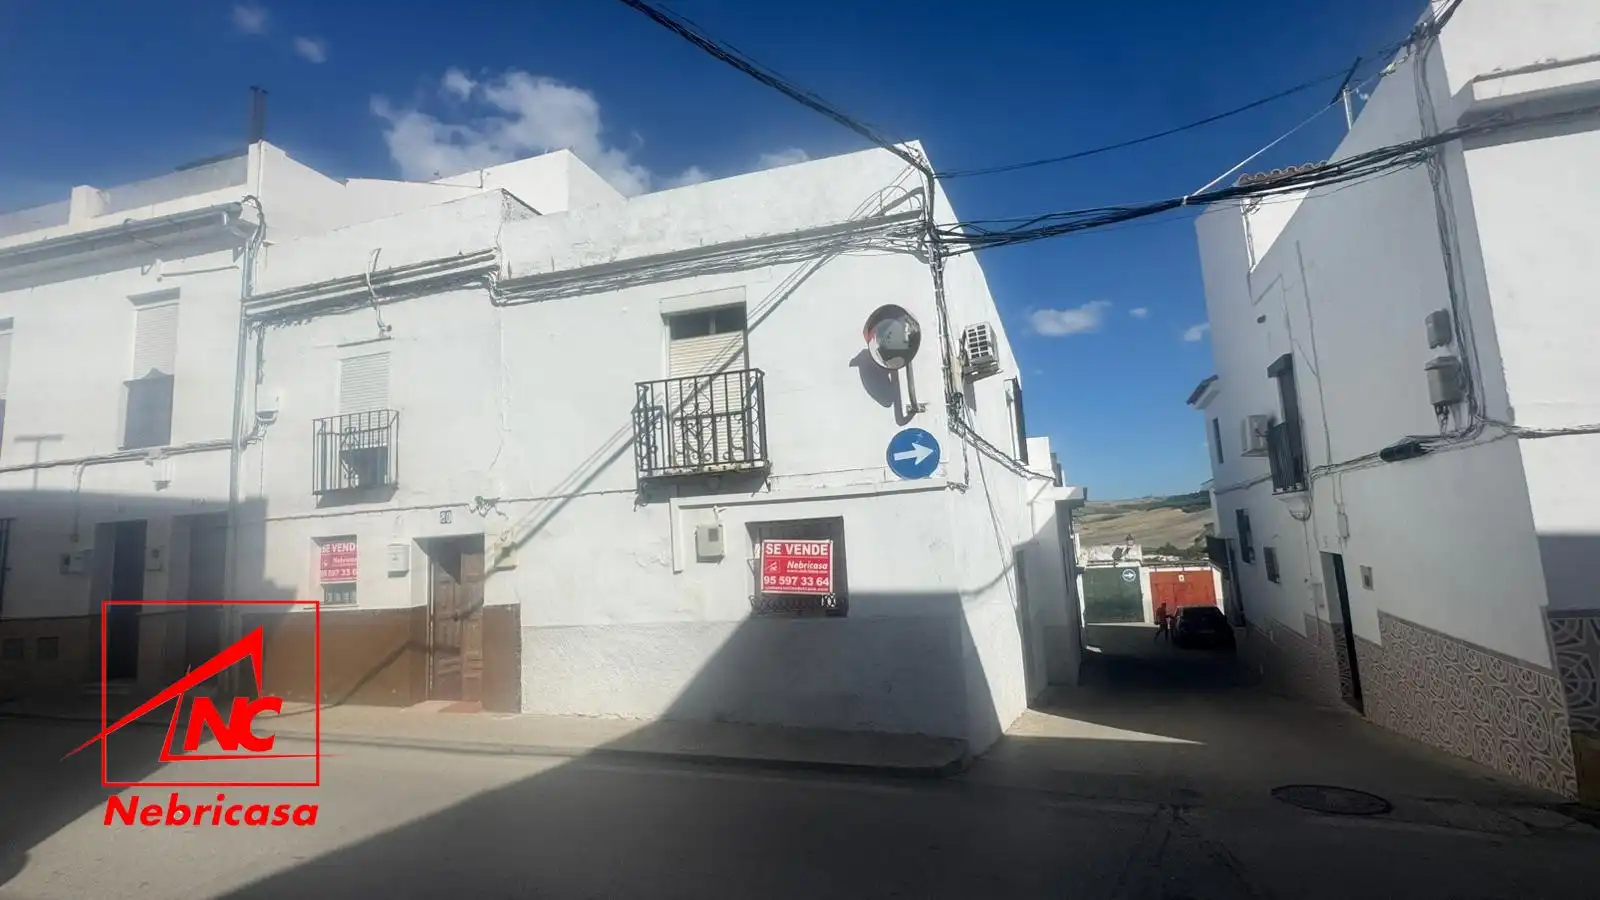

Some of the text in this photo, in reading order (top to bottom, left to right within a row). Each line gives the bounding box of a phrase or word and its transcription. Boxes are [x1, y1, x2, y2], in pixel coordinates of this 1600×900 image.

[765, 543, 828, 556] SE VENDE
[787, 561, 828, 570] Nebricasa
[763, 575, 829, 587] 95 597 33 64
